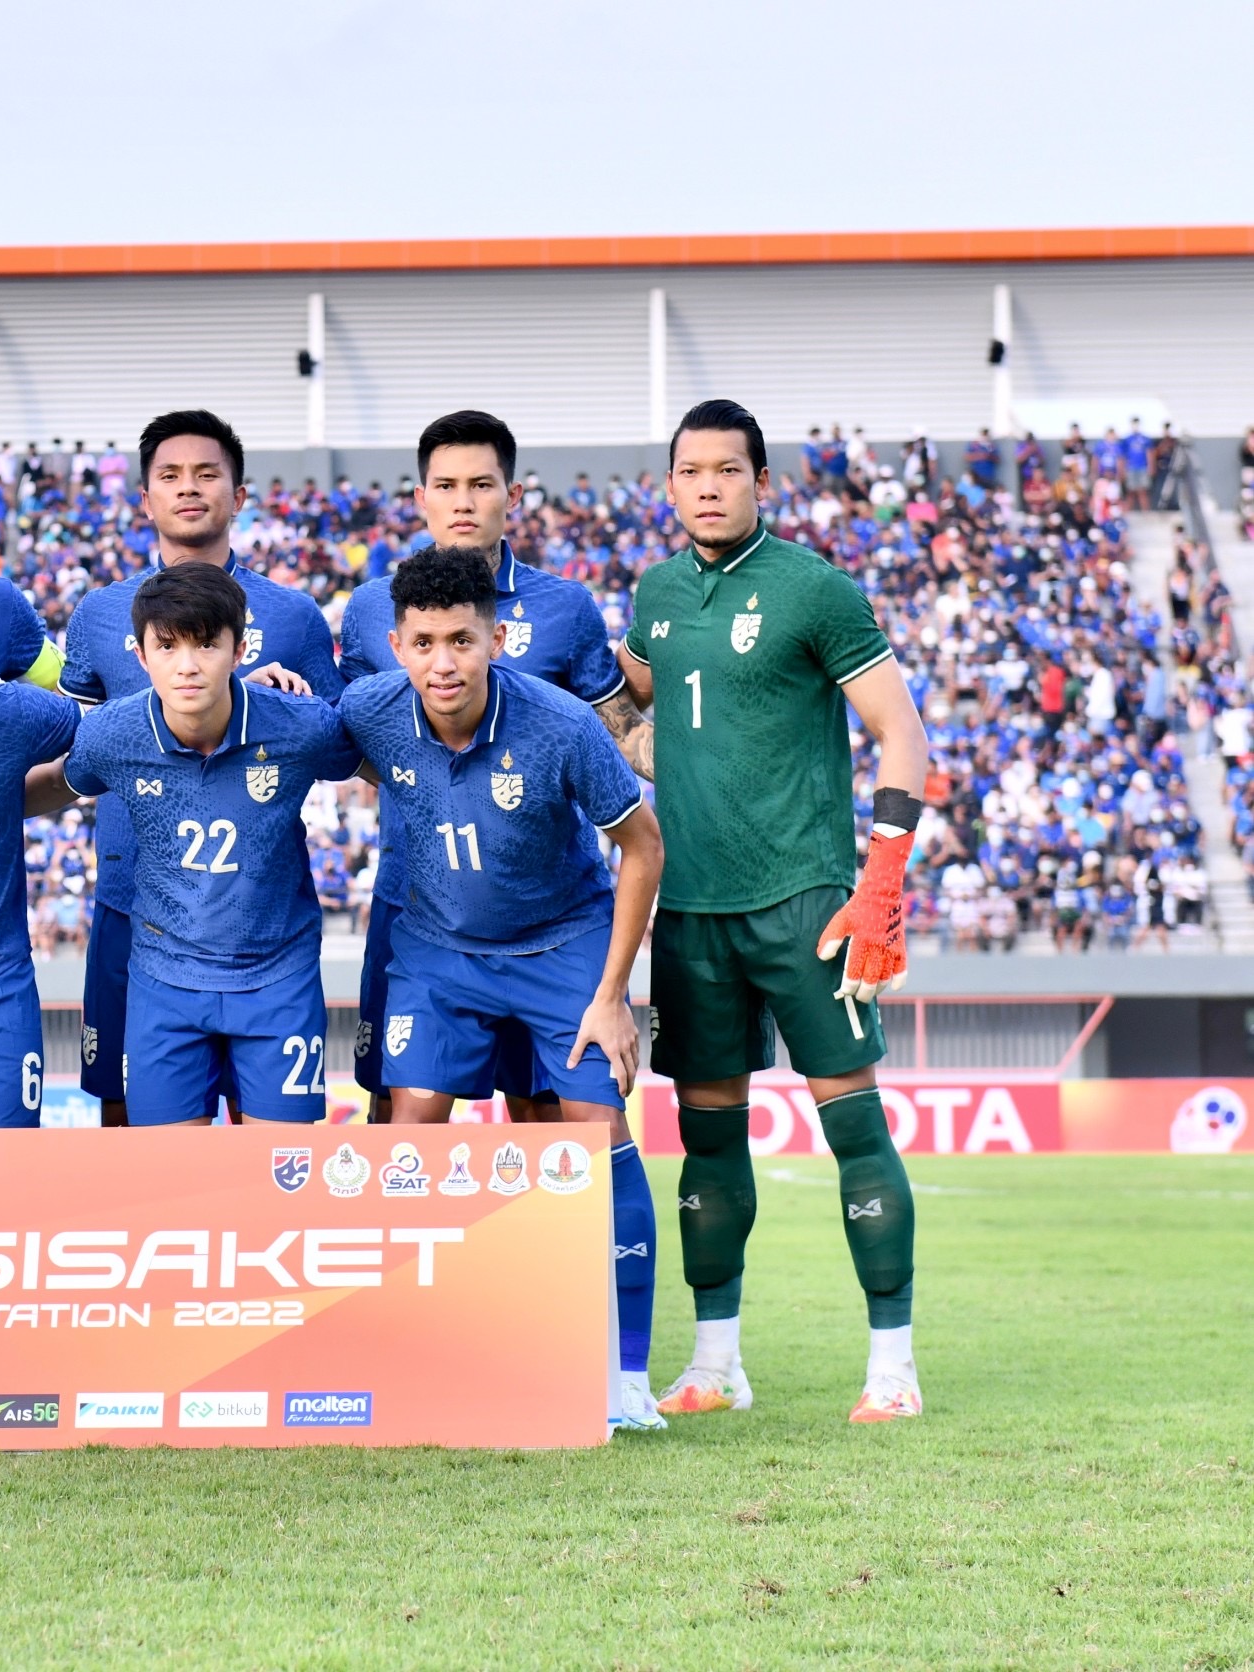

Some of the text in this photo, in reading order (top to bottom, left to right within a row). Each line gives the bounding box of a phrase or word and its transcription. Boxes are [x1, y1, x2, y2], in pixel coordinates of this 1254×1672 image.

[684, 670, 702, 729] 1
[177, 818, 239, 874] 22
[436, 822, 482, 871] 11
[21, 1051, 42, 1111] 6
[281, 1034, 325, 1096] 22
[671, 1087, 1034, 1153] OYTA
[386, 1178, 428, 1189] SAT
[174, 1300, 304, 1326] 2022
[96, 1406, 159, 1415] DAIKIN
[218, 1403, 262, 1416] bitkub
[287, 1414, 367, 1425] For the real game
[290, 1396, 366, 1412] molten
